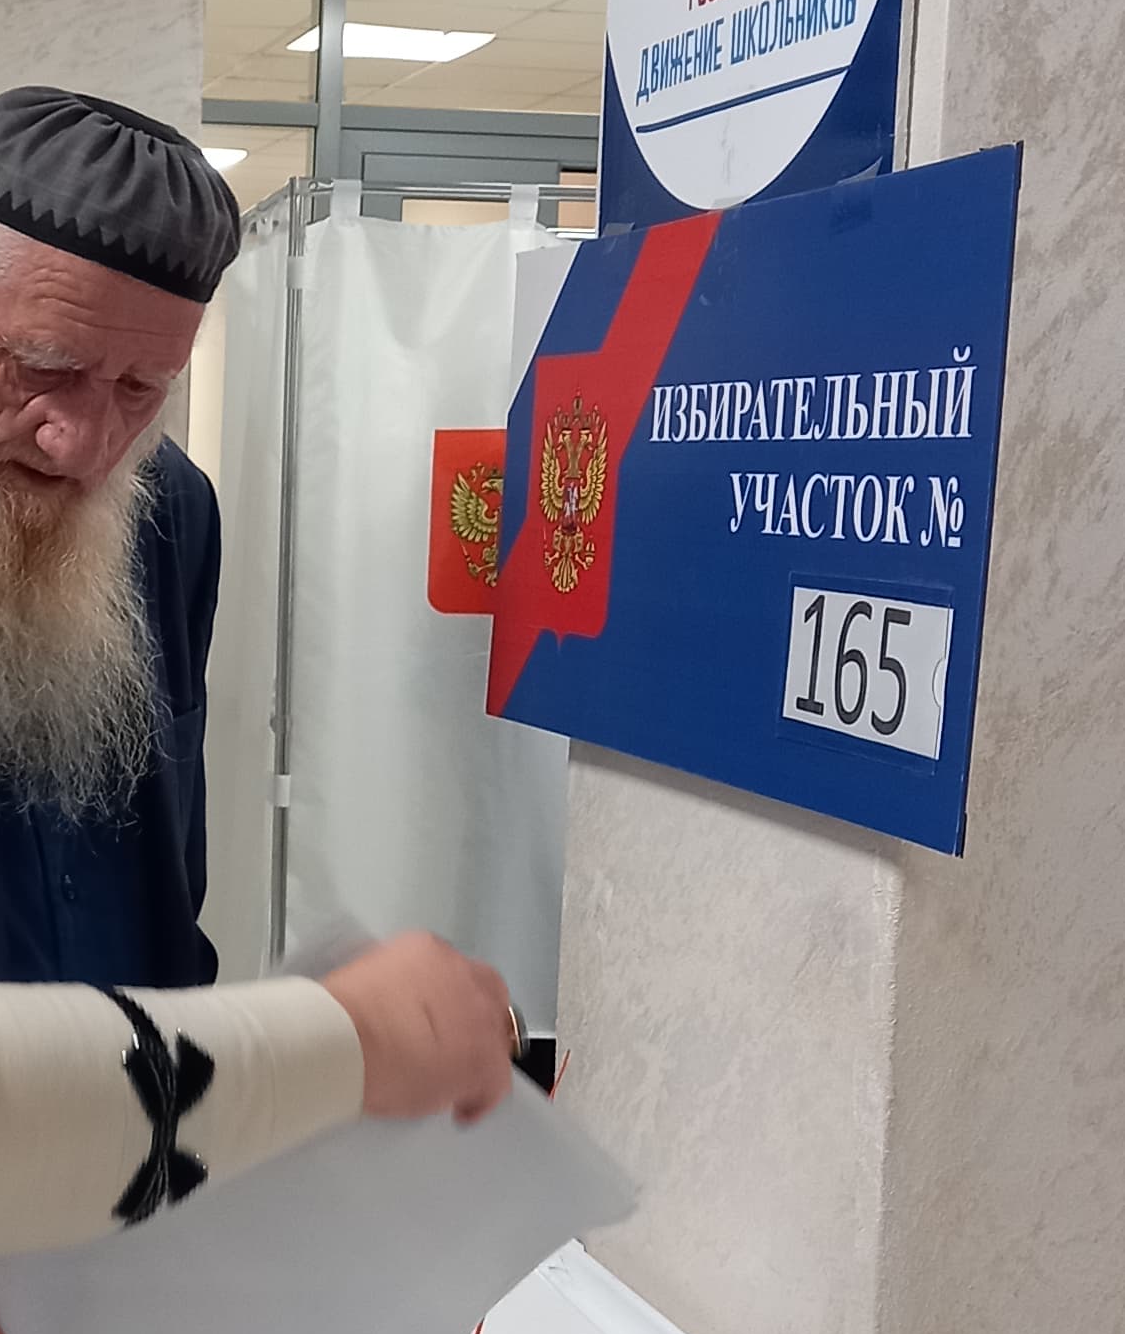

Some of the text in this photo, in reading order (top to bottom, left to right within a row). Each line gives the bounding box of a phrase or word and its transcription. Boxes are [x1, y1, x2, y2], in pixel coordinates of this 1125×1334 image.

[635, 18, 725, 108] ДВИЖЕНИЕ
[649, 346, 977, 443] ИЗБИРАТЕЛЬНЫЙ
[729, 472, 964, 548] УЧАСТОК №
[794, 594, 911, 735] 165
